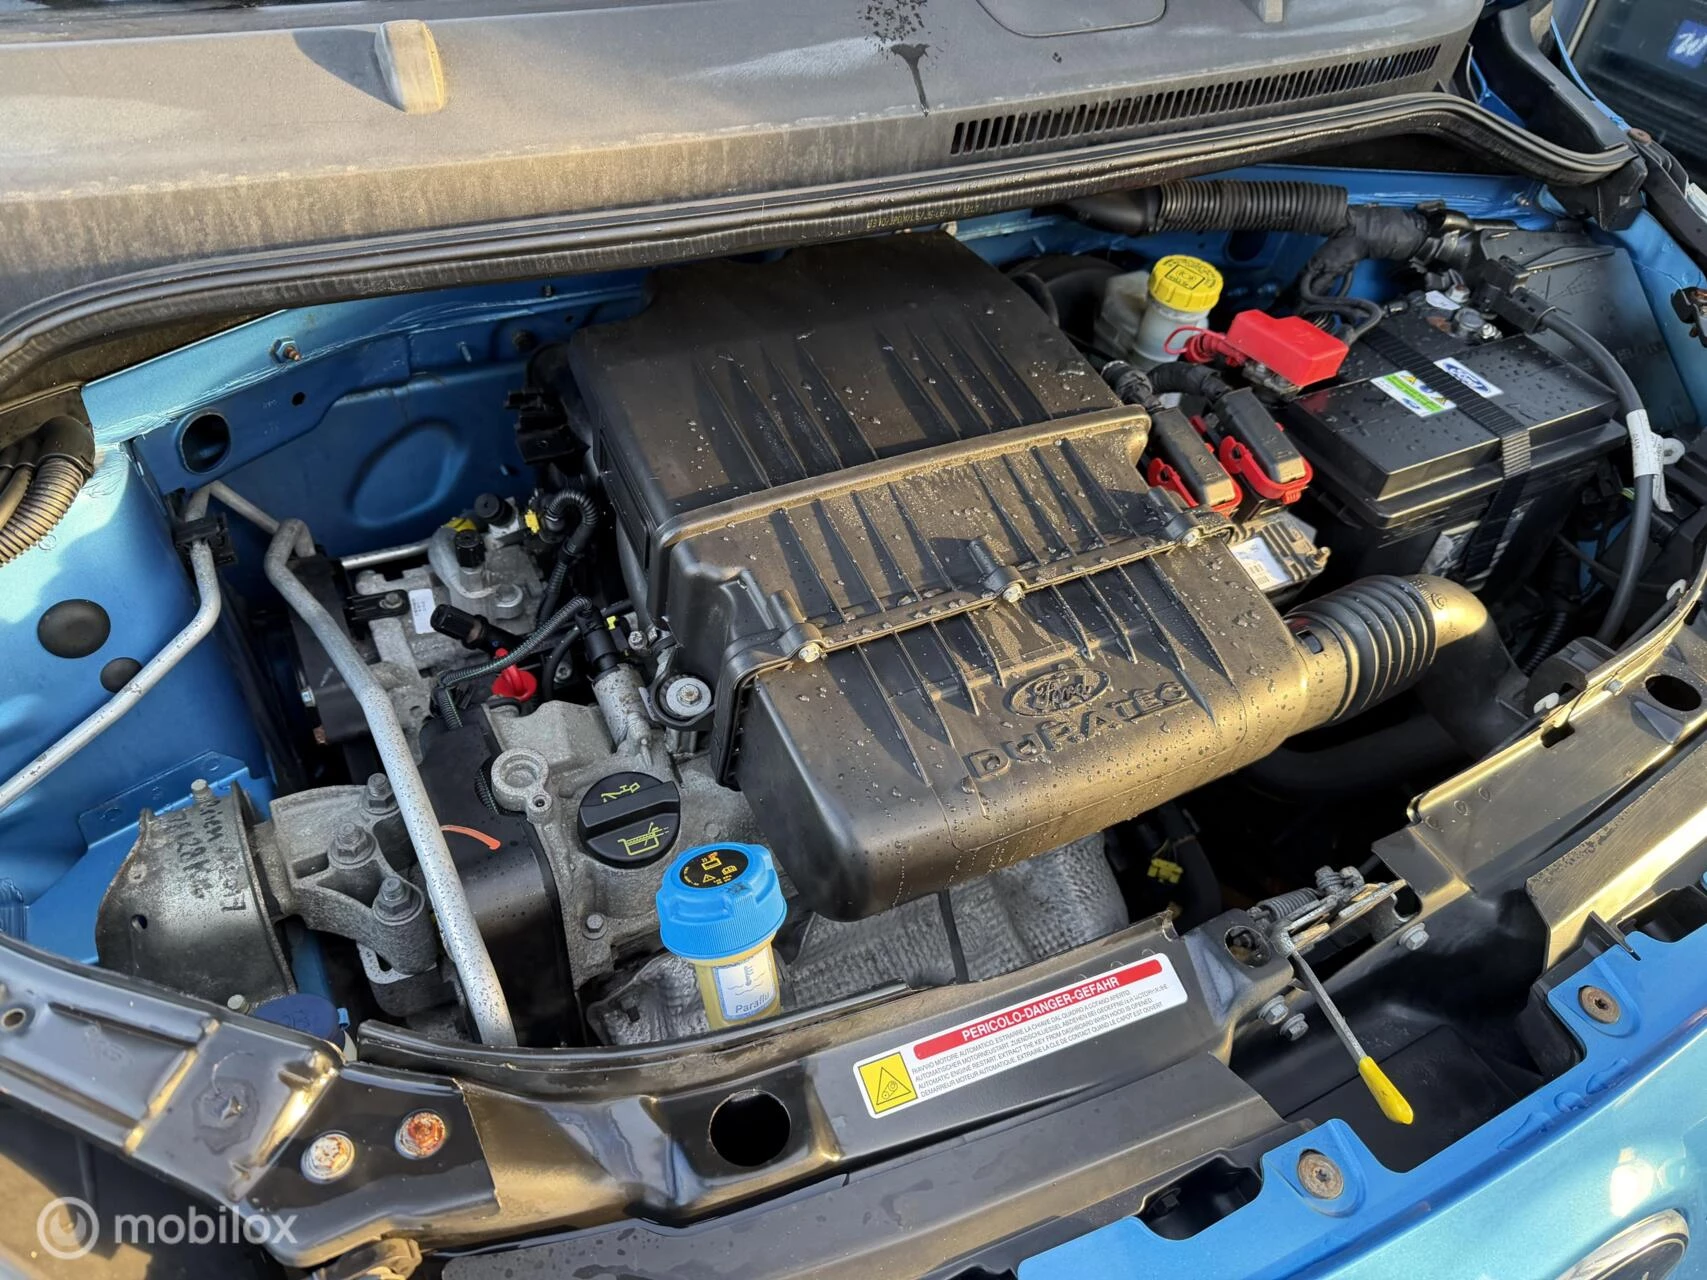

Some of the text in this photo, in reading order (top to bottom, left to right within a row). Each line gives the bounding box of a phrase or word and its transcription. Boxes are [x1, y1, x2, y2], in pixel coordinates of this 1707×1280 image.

[967, 681, 1188, 780] DURATEC
[735, 991, 771, 1014] Paraflu
[959, 975, 1121, 1042] PERICOLO-DANGER-GEFAHR
[916, 1072, 951, 1090] AUTOMATIC
